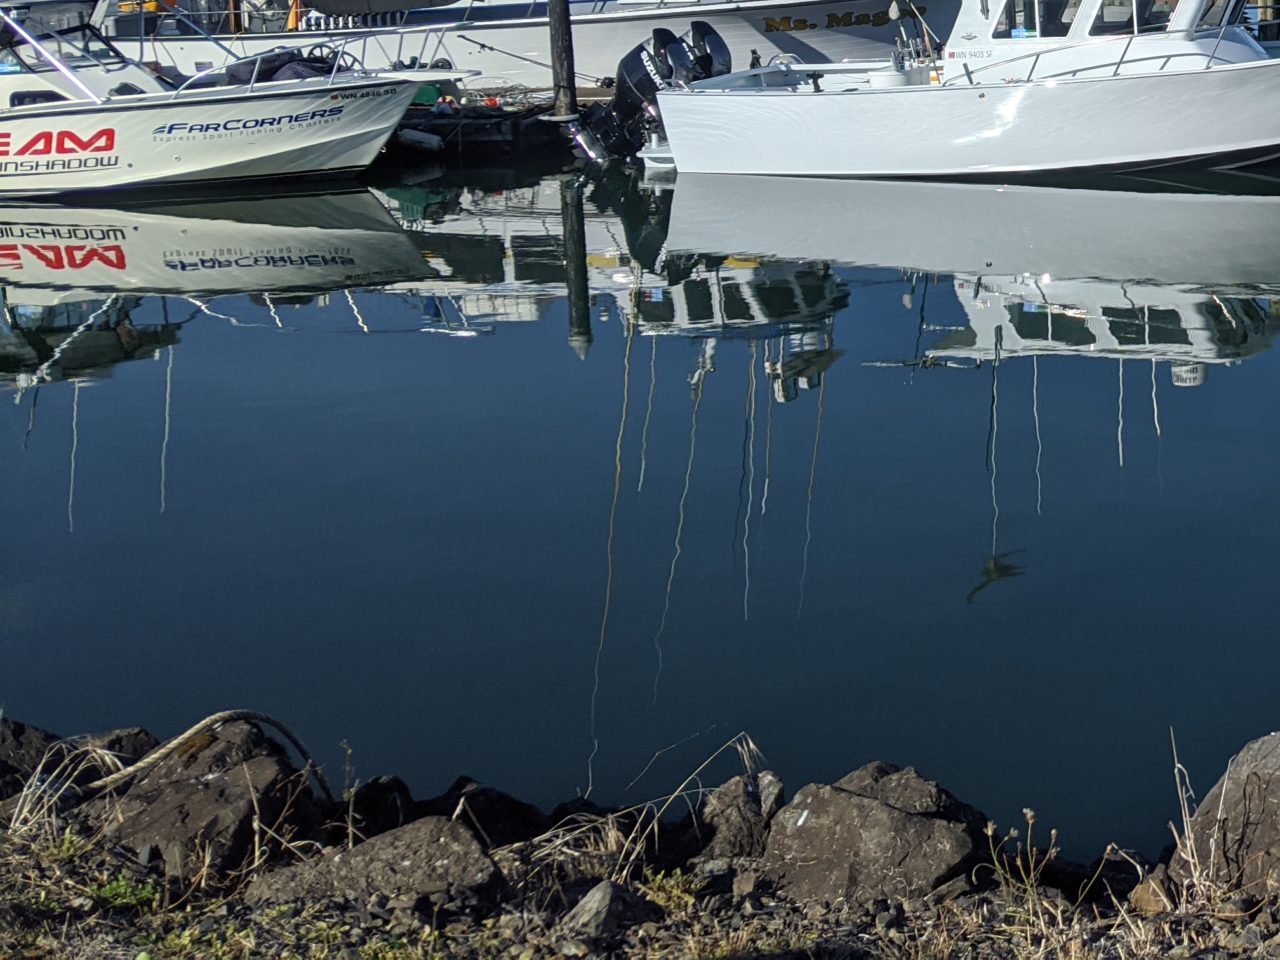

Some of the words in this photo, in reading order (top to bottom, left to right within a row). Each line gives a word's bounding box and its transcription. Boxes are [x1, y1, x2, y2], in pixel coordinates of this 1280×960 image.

[763, 15, 818, 33] Ms.
[640, 50, 666, 90] SUZUKI
[340, 92, 357, 100] WN
[202, 132, 233, 140] Sport
[240, 127, 282, 136] Fishing
[289, 117, 341, 130] Charters
